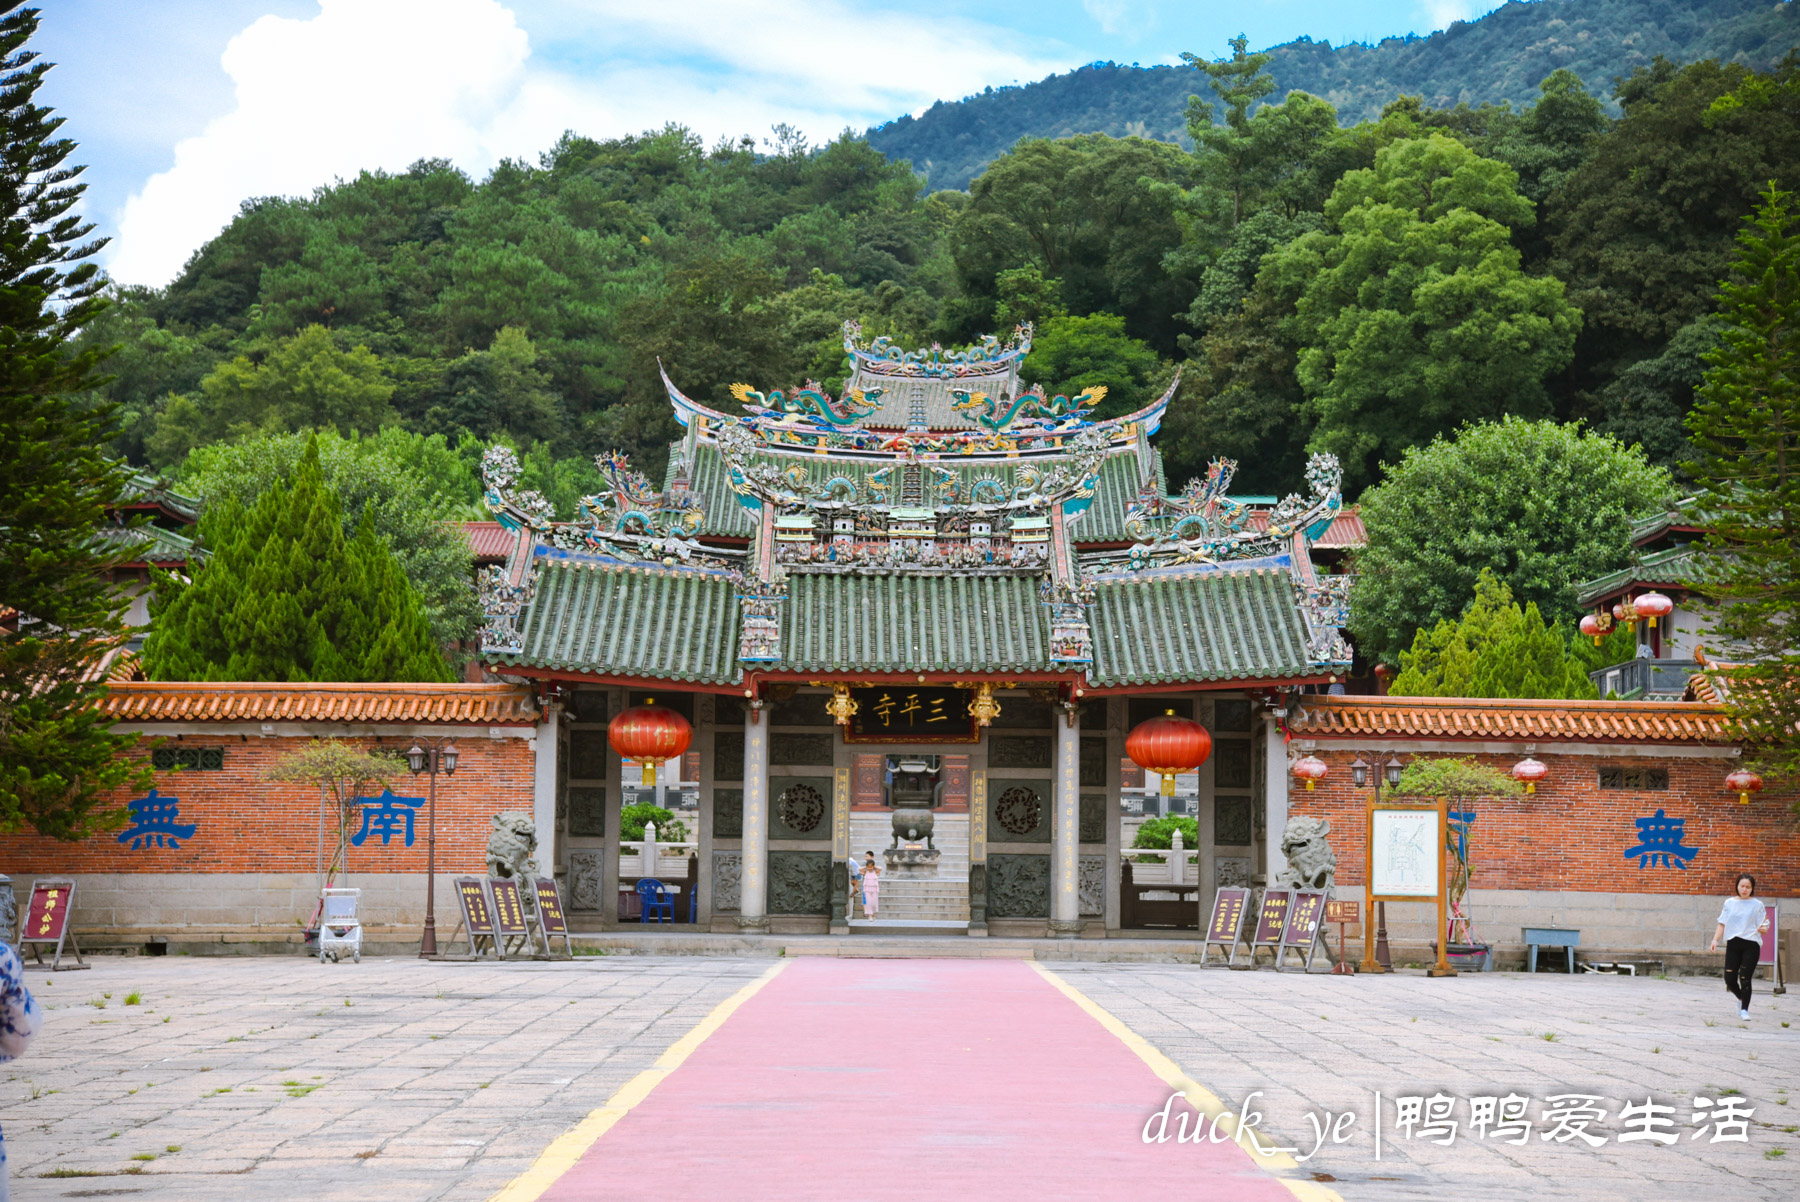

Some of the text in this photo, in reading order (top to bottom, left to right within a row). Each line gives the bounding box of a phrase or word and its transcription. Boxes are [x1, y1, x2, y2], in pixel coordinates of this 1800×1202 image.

[872, 693, 949, 728] 三平寺
[117, 788, 197, 851] 無
[351, 789, 427, 848] 南
[1623, 808, 1700, 871] 無
